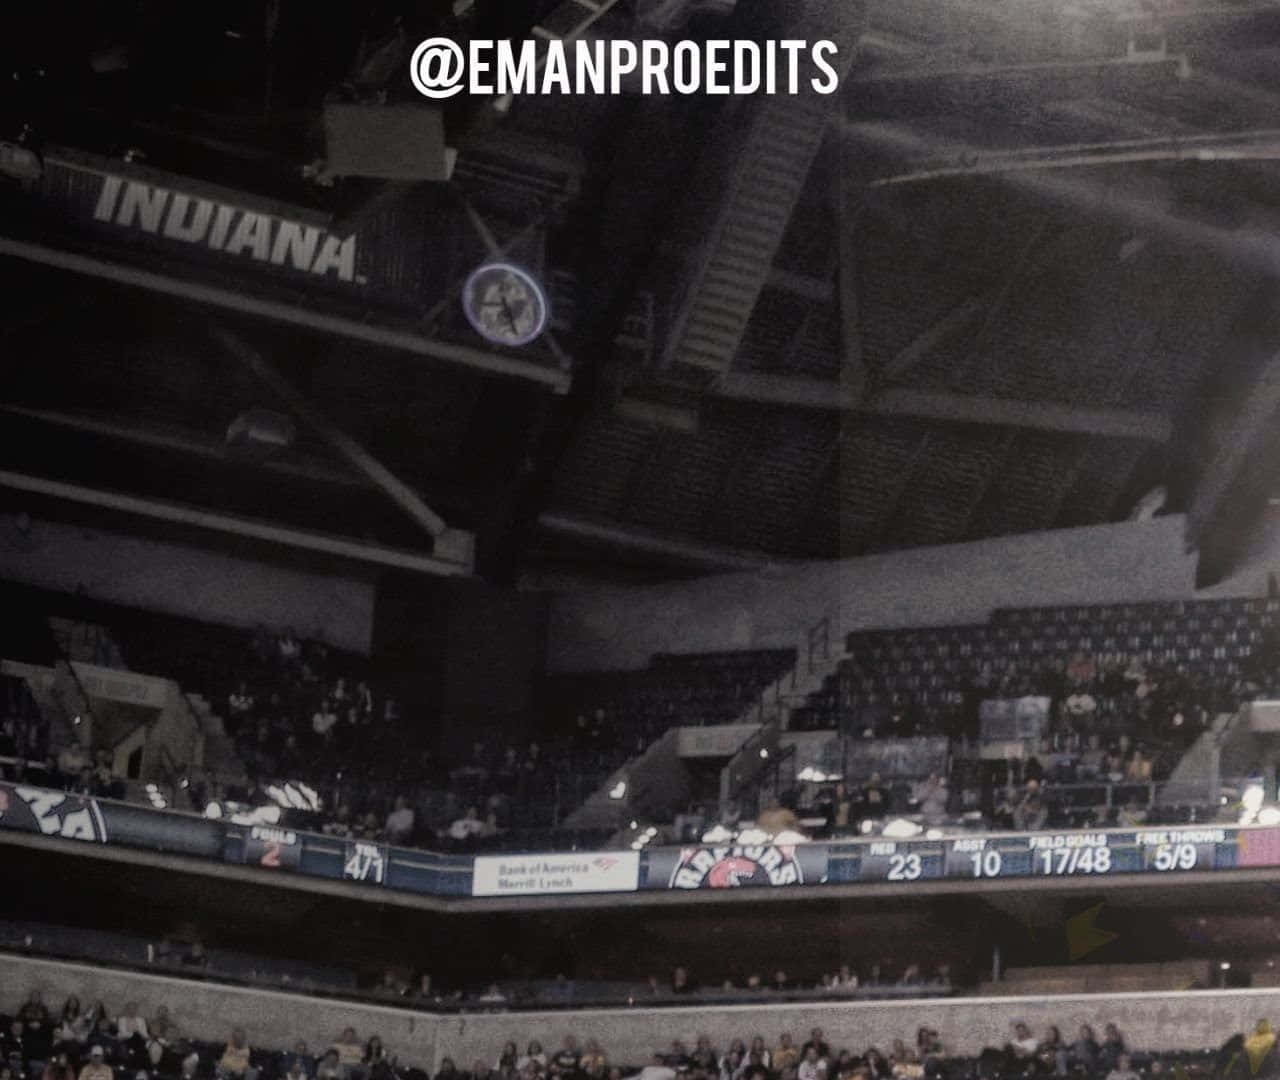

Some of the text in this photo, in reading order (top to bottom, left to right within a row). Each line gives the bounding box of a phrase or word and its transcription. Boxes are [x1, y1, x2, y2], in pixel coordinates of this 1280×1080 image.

[887, 854, 922, 881] 23
[971, 851, 1001, 877] 10
[1040, 848, 1112, 875] 17/48
[1154, 844, 1198, 871] 5/9
